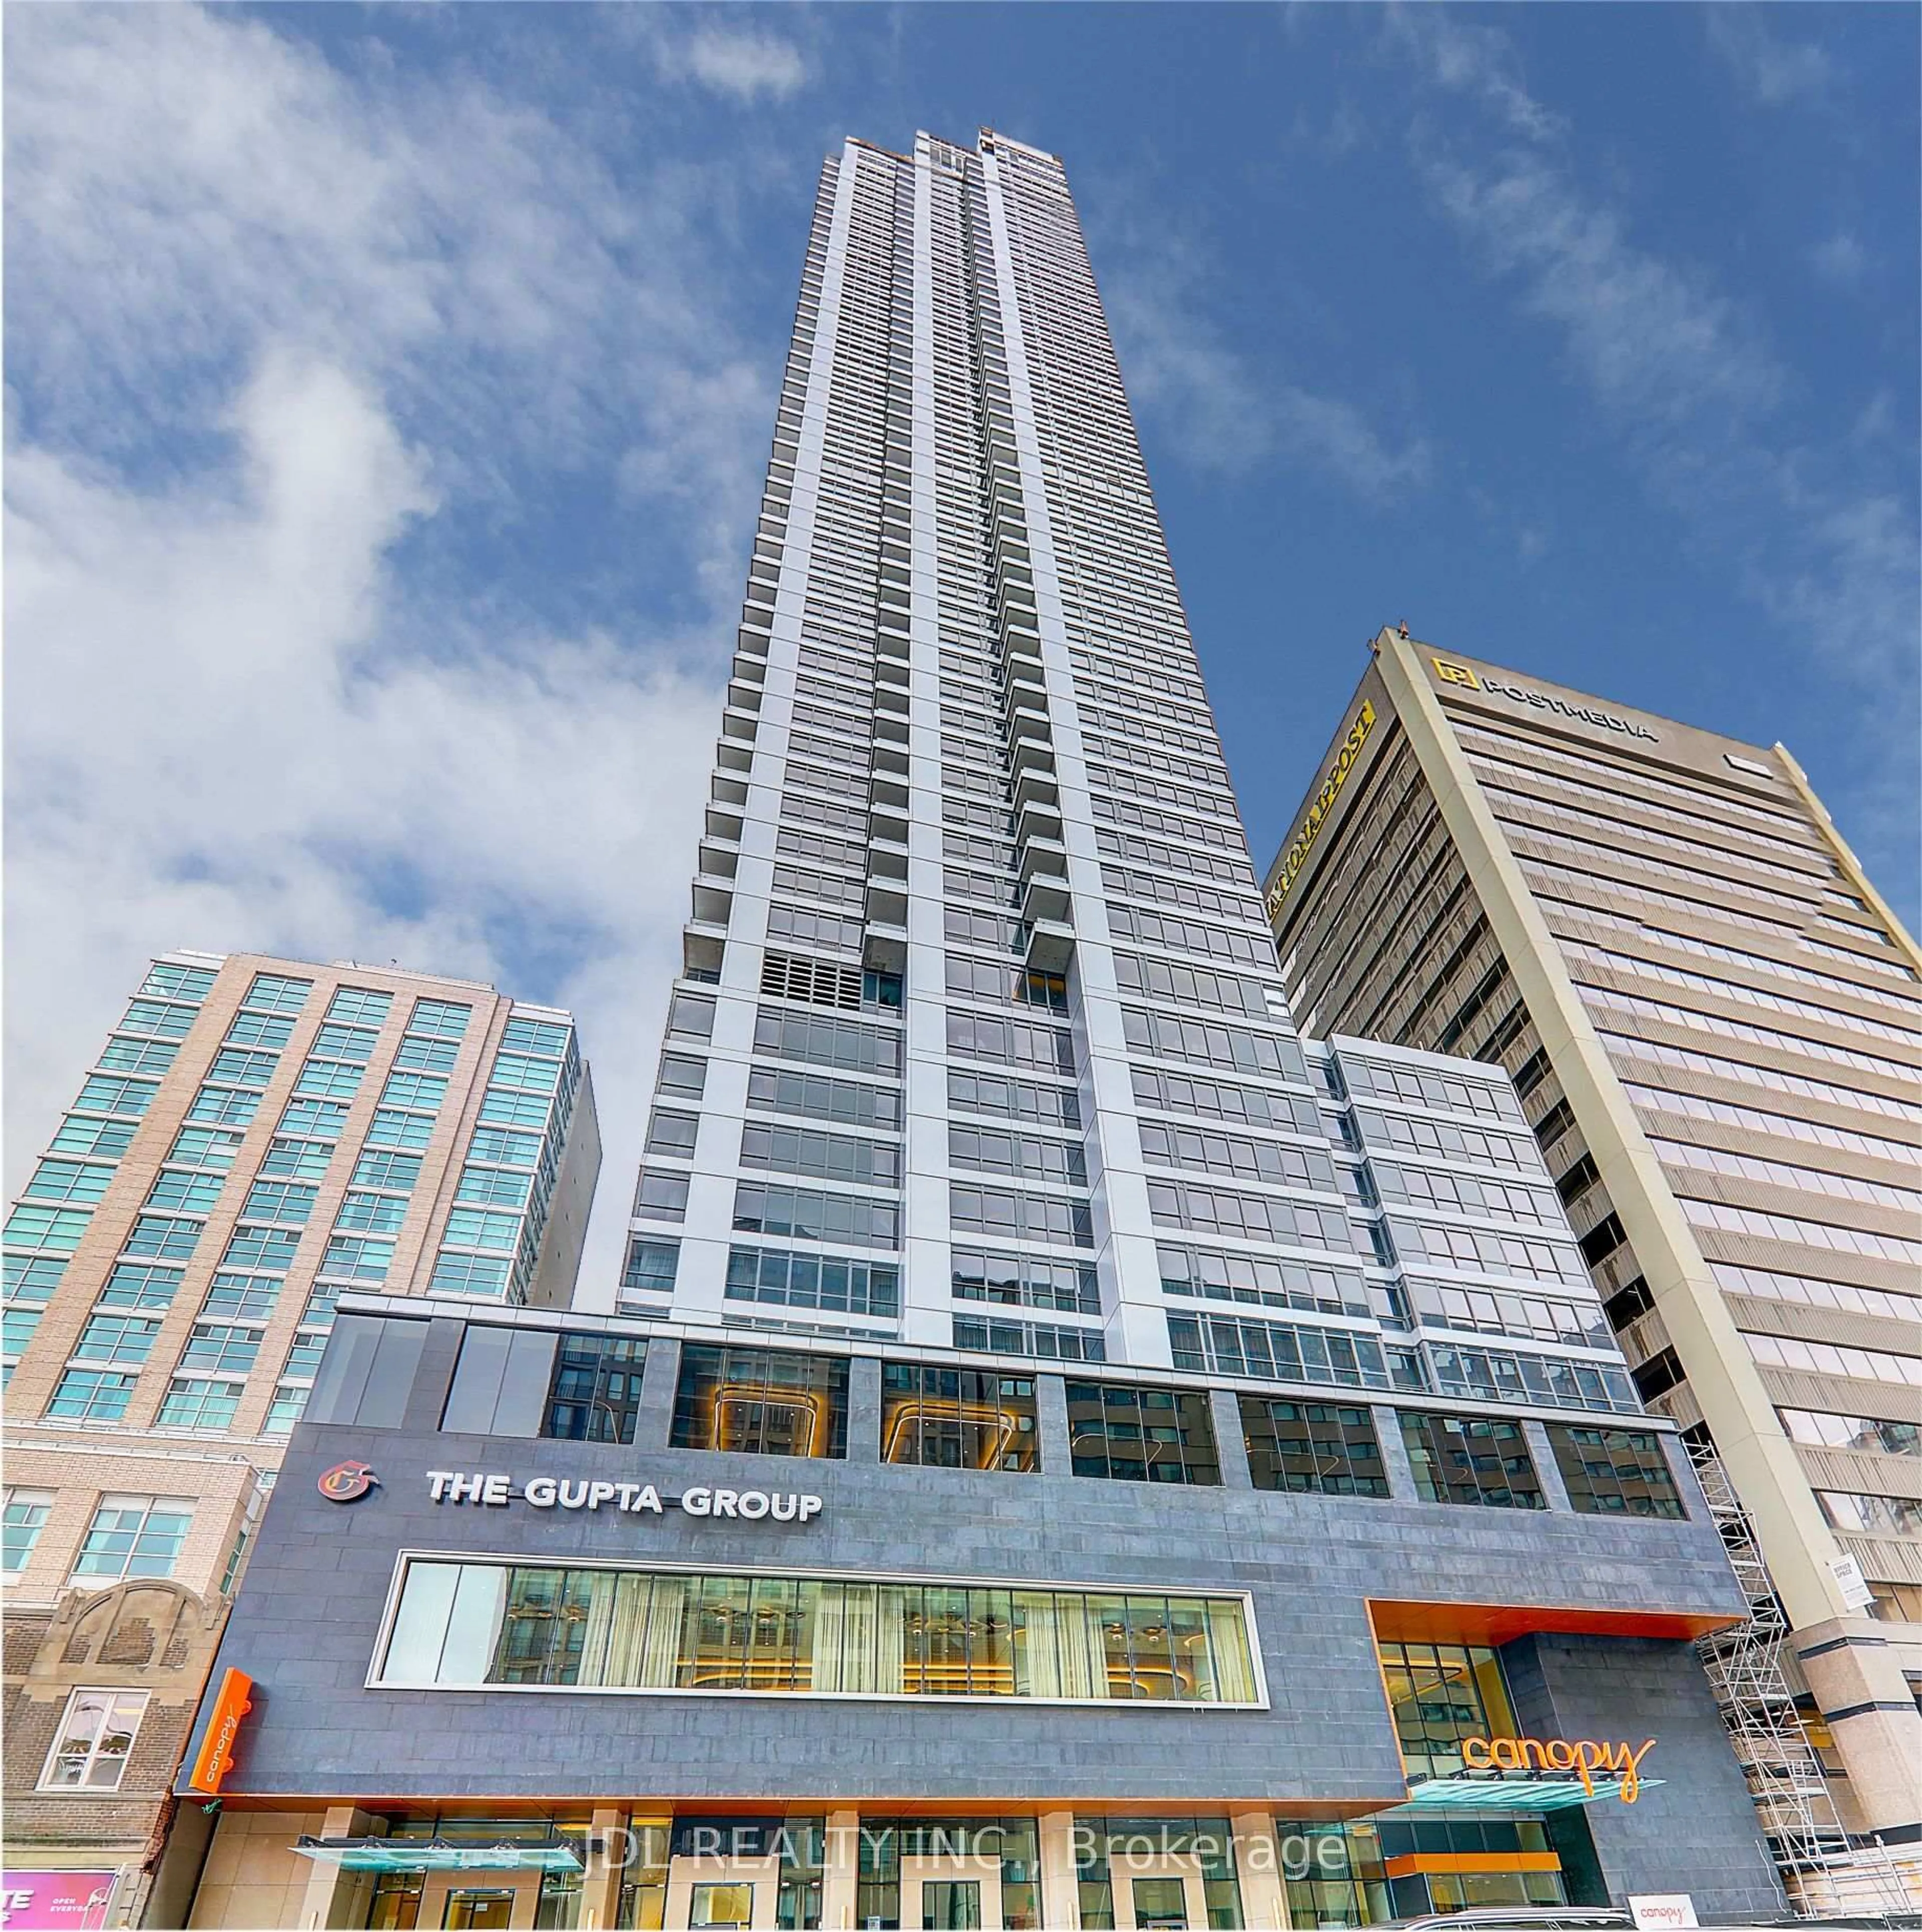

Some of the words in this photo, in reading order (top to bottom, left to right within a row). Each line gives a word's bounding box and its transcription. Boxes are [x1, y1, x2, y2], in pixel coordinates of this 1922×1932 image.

[1482, 676, 1659, 743] POSTMEDIA
[1266, 785, 1330, 919] ATIONAL
[1327, 705, 1370, 794] POST
[426, 1471, 510, 1504] THE
[525, 1478, 662, 1513] GUPTA
[682, 1487, 822, 1522] GROUP
[206, 1704, 237, 1782] canopy
[1462, 1737, 1657, 1804] canopy
[1640, 1906, 1686, 1924] canopy
